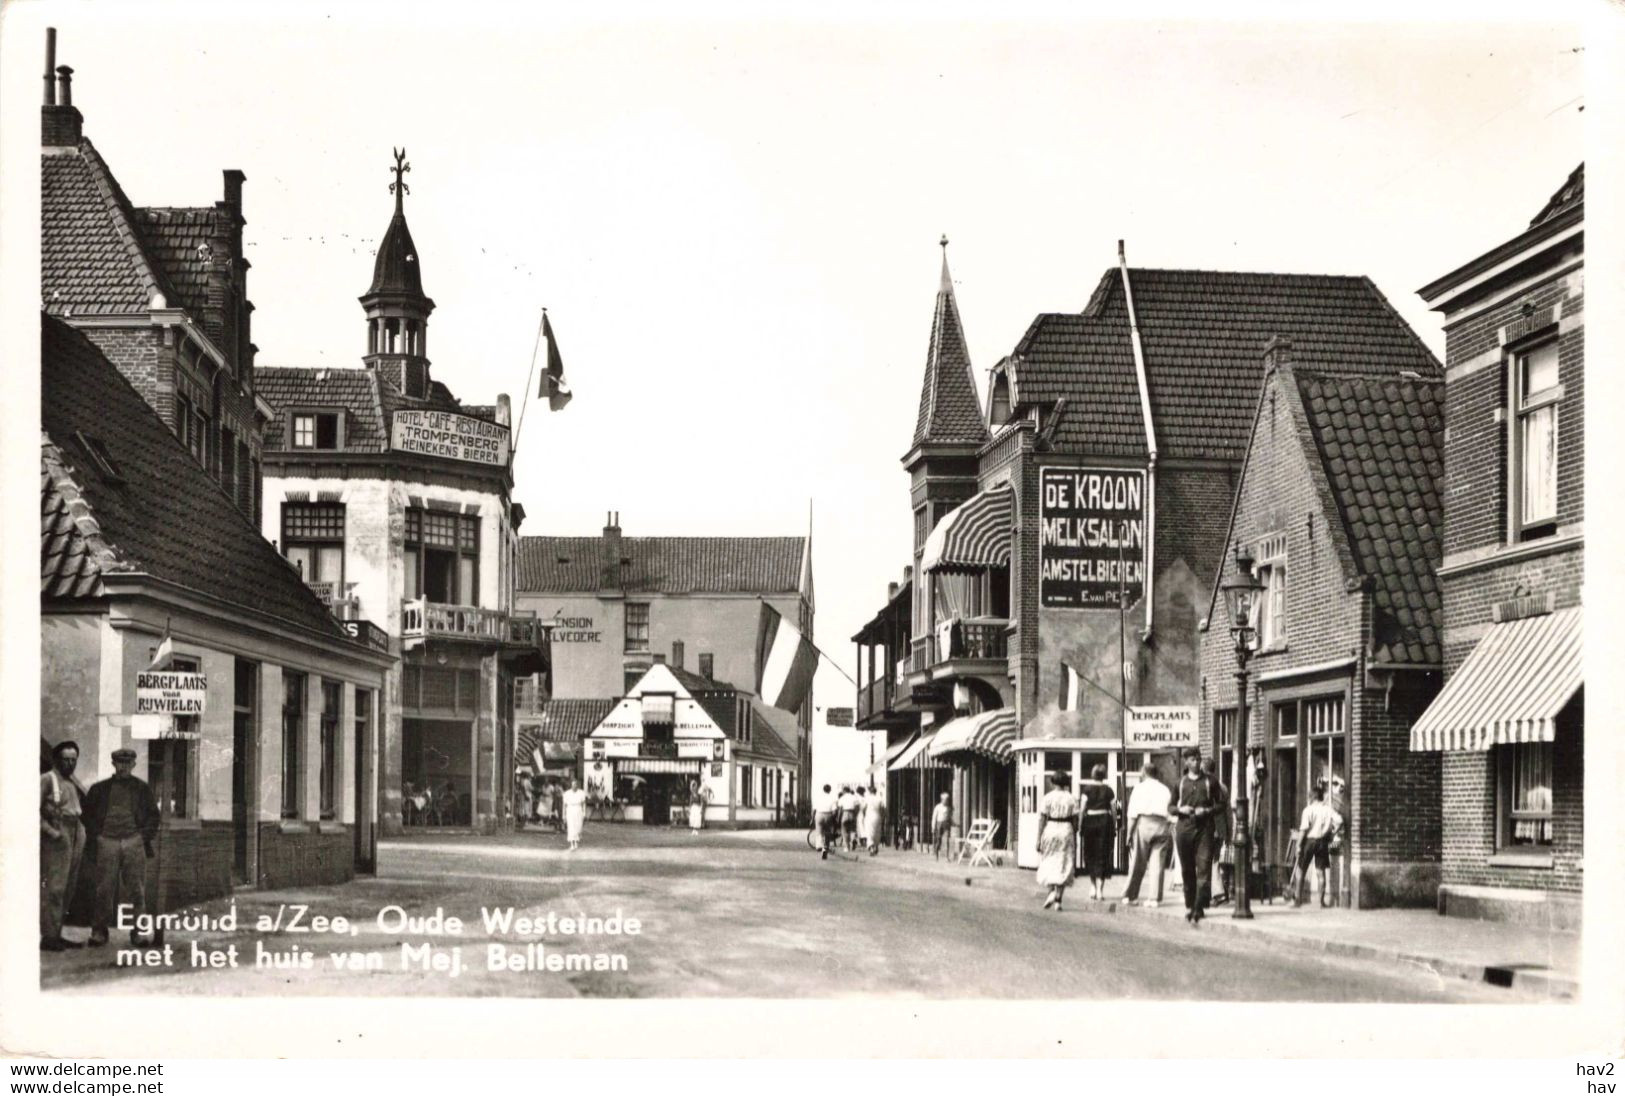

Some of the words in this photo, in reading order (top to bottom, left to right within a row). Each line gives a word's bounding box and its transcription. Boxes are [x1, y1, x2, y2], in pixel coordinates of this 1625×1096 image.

[402, 439, 458, 457] HEINEKENS
[463, 448, 499, 463] BIEREN
[1045, 484, 1069, 509] DE
[1074, 474, 1141, 511] KROON
[1042, 517, 1142, 549] MELKSALON
[1042, 559, 1143, 583] AMSTELBIEREN
[1105, 591, 1120, 603] PE
[554, 617, 593, 628] ENSION
[137, 674, 207, 690] BERGPLAATS
[138, 698, 202, 712] RIJWIELEN
[1132, 712, 1191, 721] BERGPLAATS
